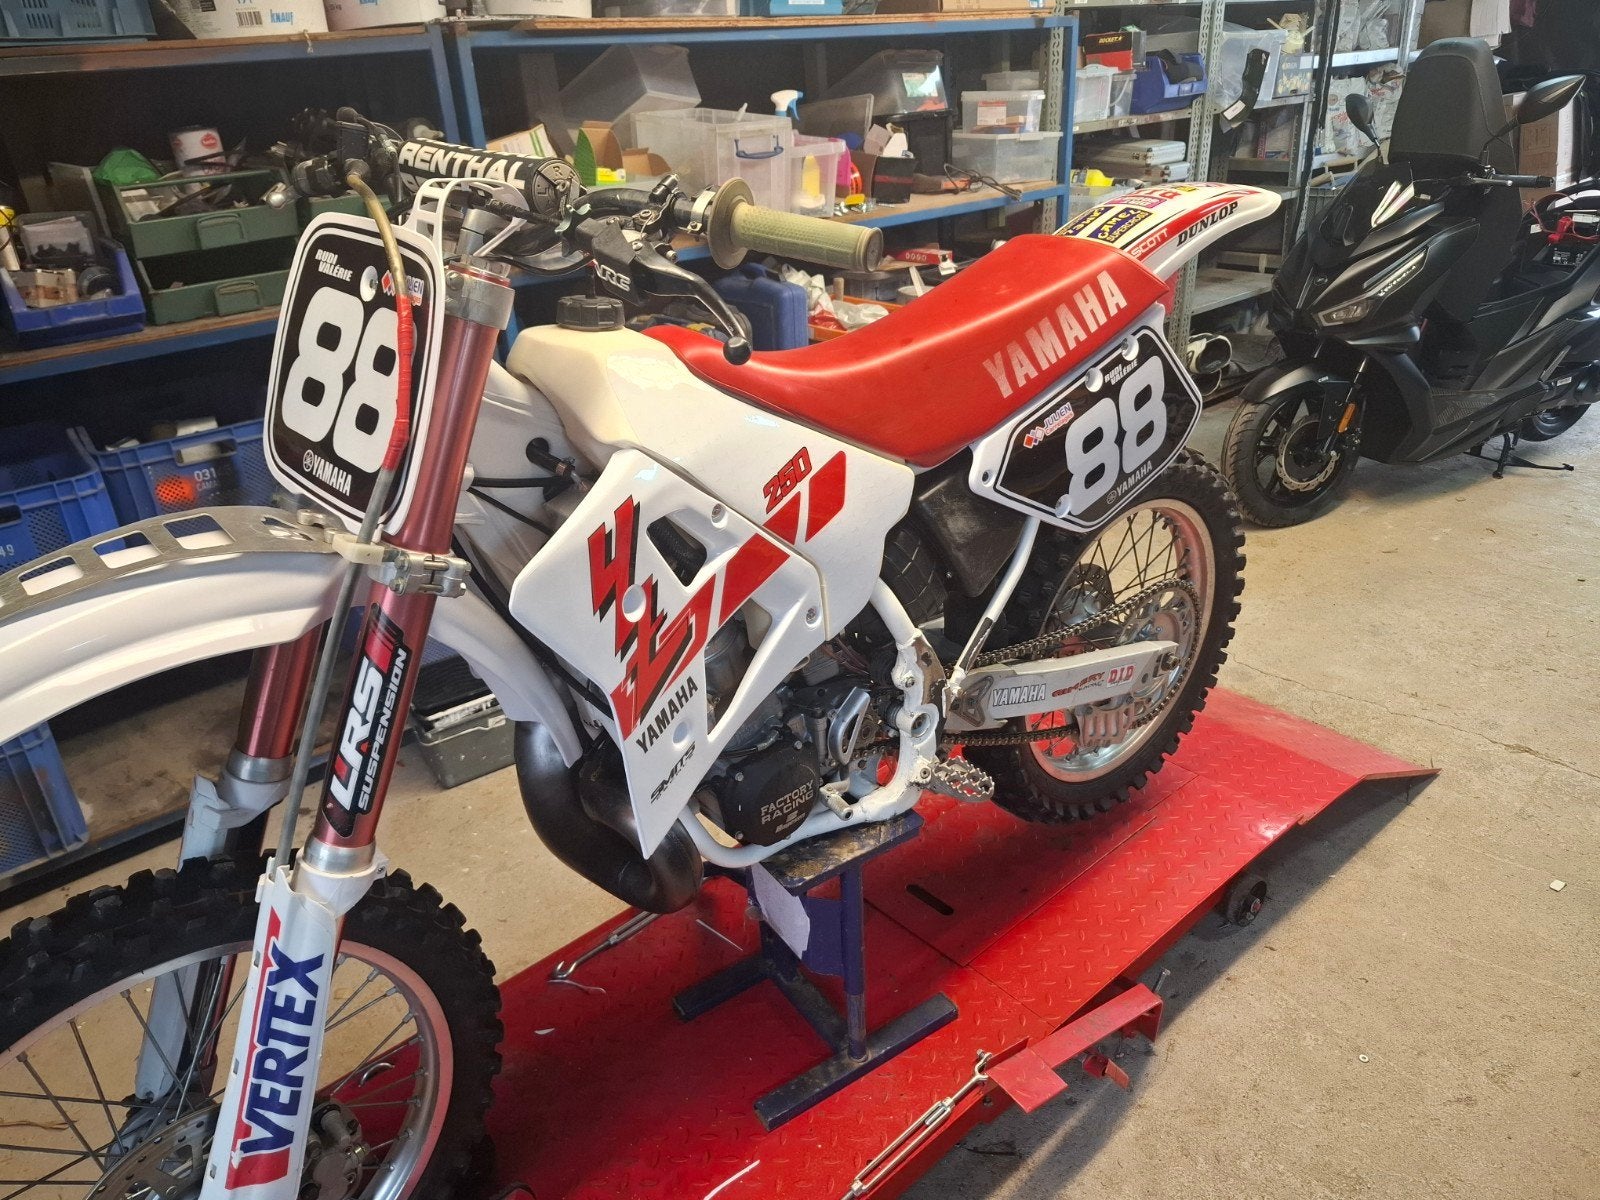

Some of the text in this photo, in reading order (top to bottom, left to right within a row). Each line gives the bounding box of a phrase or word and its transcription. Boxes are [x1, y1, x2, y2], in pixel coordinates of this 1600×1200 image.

[269, 9, 295, 26] KNAUF
[398, 142, 527, 191] RENTHAL
[1097, 207, 1142, 240] CAMEL
[1176, 201, 1239, 248] DUNLOP
[315, 249, 339, 265] RUDI
[1131, 228, 1169, 258] SCOTT
[318, 264, 354, 282] VALÉRIE
[982, 270, 1128, 399] YAMAHA
[282, 286, 418, 474] 88
[1104, 363, 1123, 383] RUDI
[1043, 403, 1073, 429] JULIEN
[1065, 355, 1168, 516] 88
[193, 467, 218, 482] 031
[312, 454, 353, 497] YAMAHA
[762, 446, 813, 515] 250
[1115, 461, 1153, 497] YAMAHA
[993, 683, 1047, 707] YAMAHA
[357, 647, 408, 811] SUSPENSION
[636, 675, 699, 754] YAMAHA
[330, 655, 384, 811] LRS
[760, 780, 814, 816] FACTORY
[761, 790, 814, 825] RACING
[240, 941, 326, 1154] VERTEX
